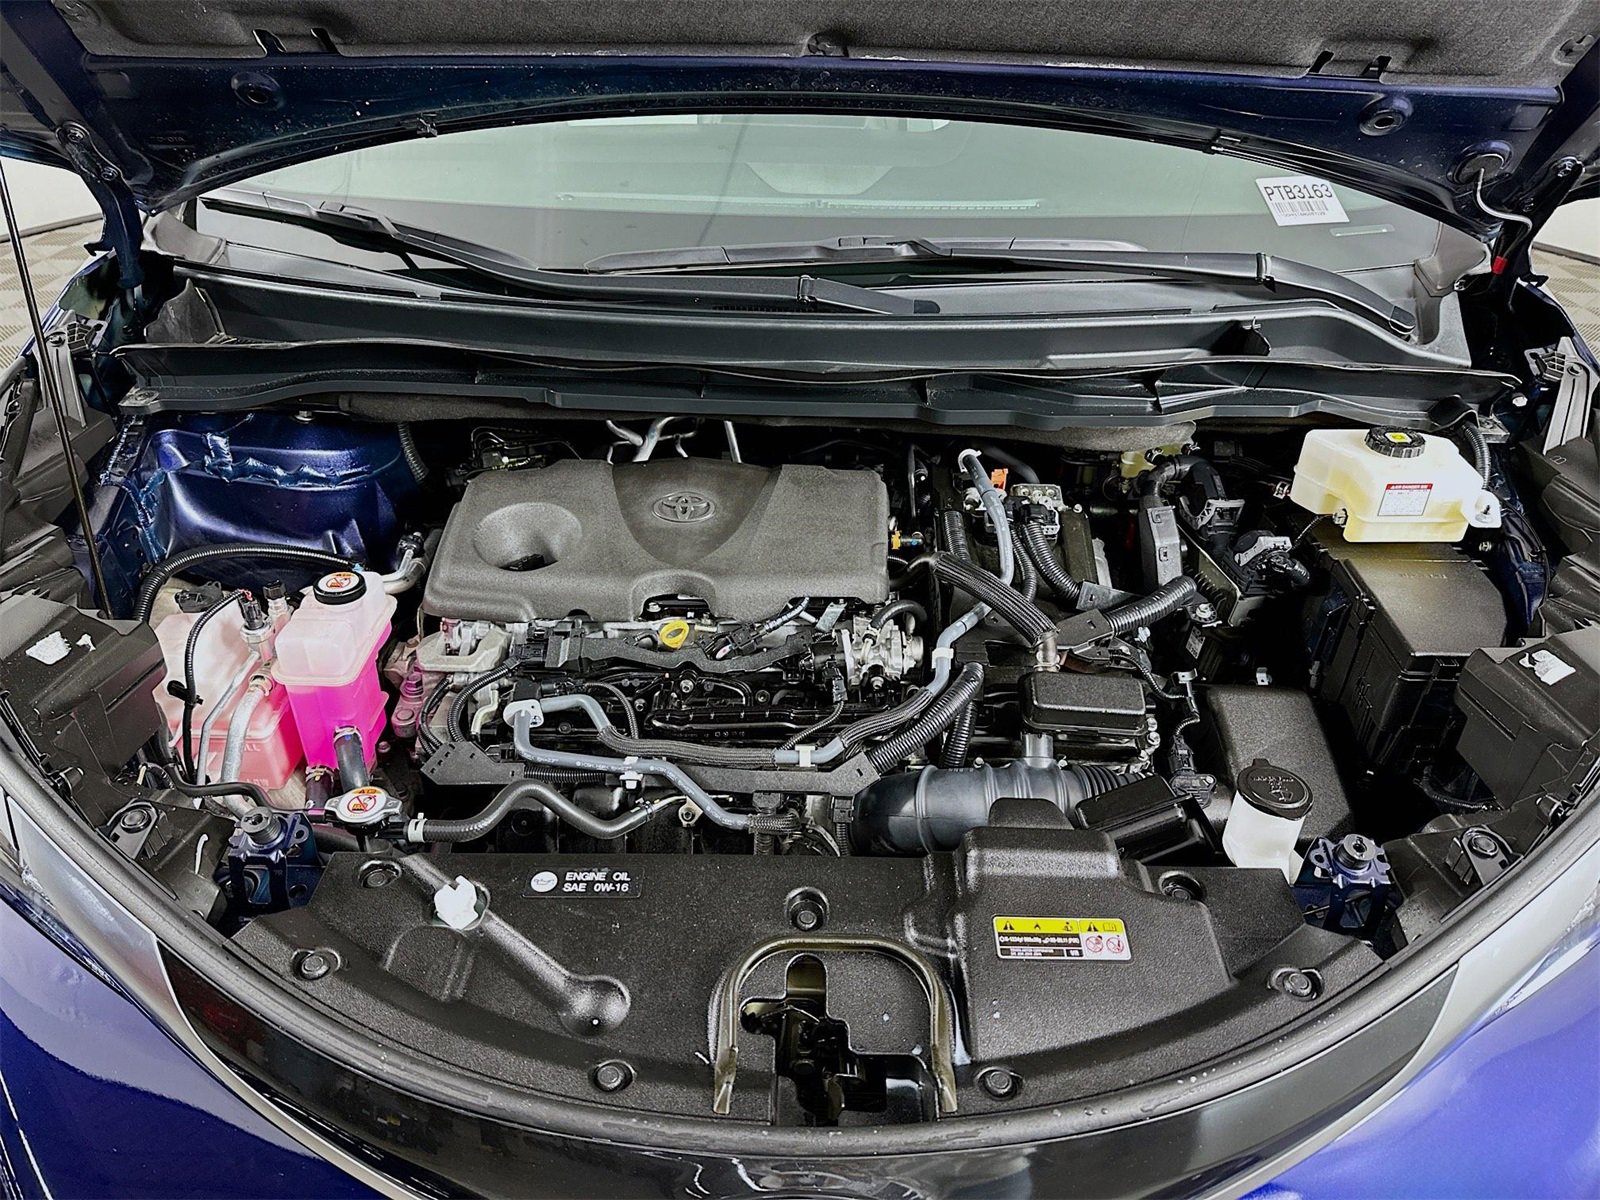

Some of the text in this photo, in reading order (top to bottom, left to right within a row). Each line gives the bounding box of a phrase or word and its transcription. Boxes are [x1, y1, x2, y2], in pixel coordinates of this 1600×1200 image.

[1263, 183, 1333, 201] PTB3163
[565, 871, 631, 881] ENGINE OIL
[562, 882, 629, 892] SAE 0W-16
